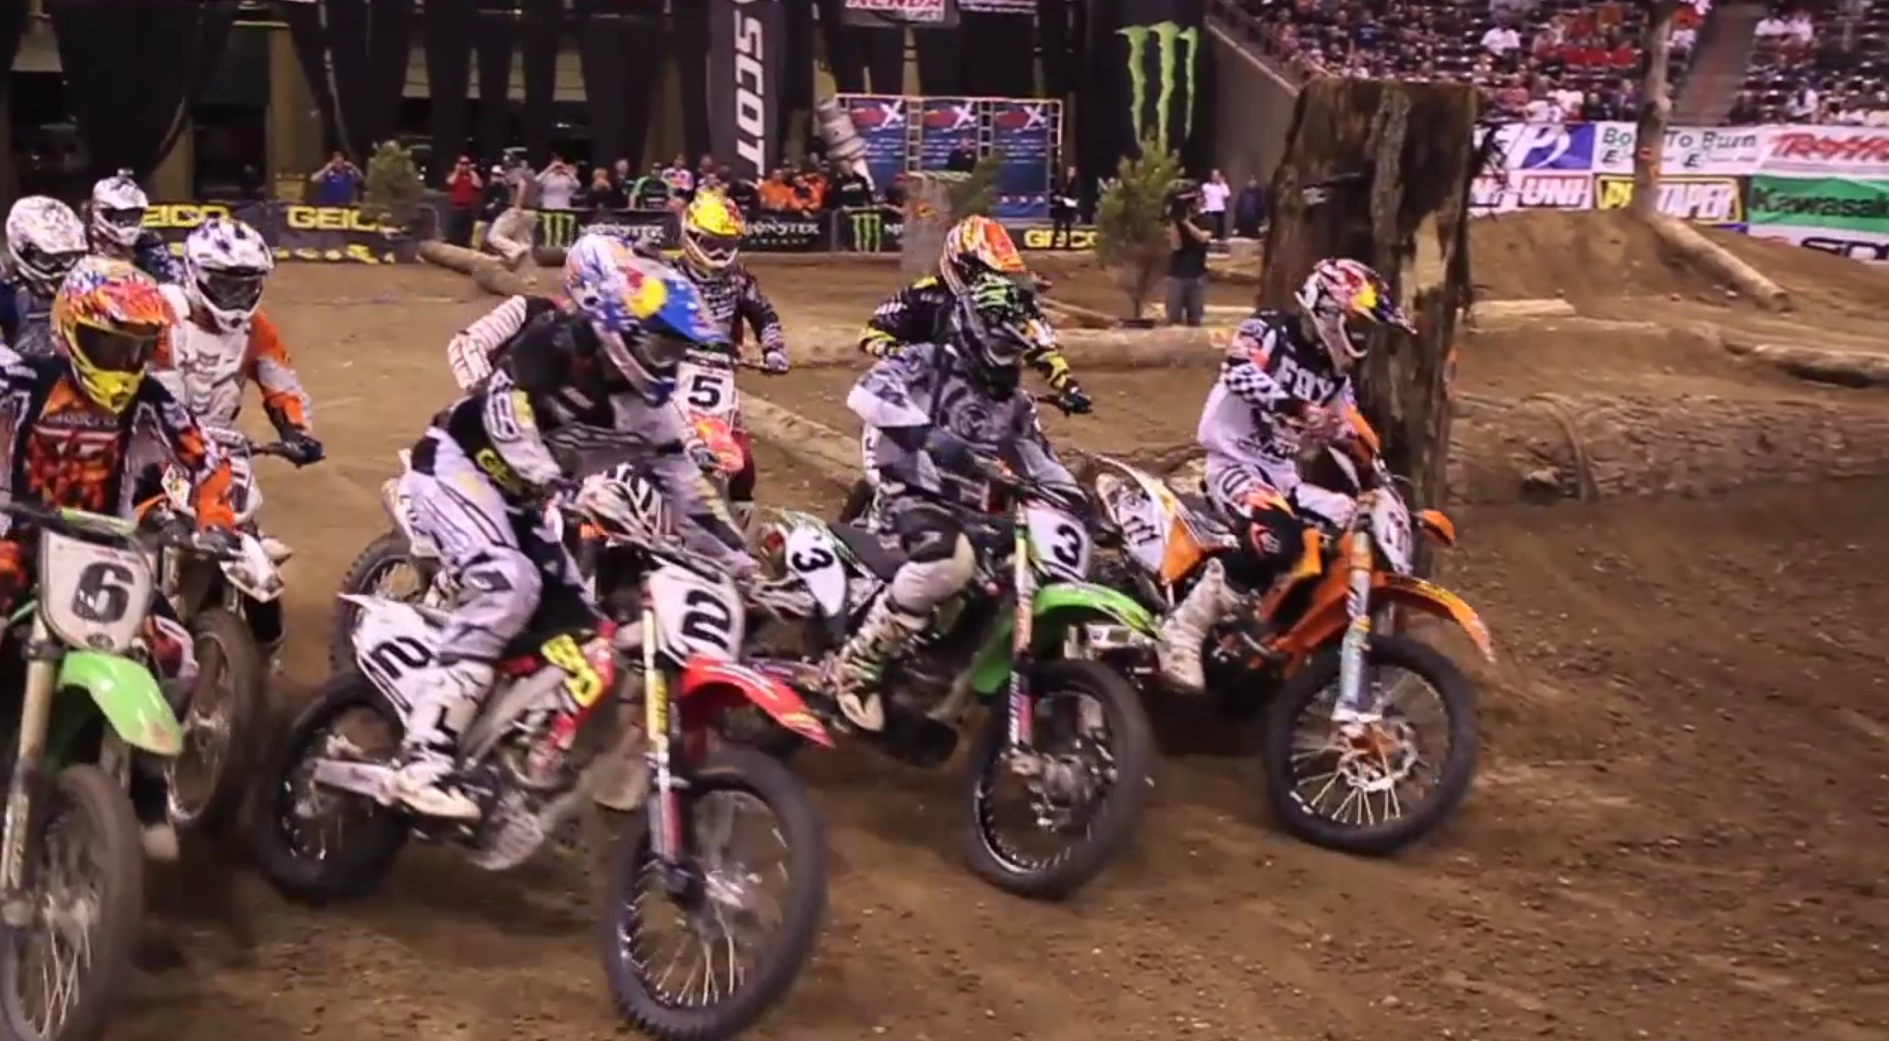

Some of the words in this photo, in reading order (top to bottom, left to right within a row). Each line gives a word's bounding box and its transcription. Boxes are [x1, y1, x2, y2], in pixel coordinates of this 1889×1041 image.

[734, 10, 765, 184] SCOT
[1602, 127, 1633, 146] Bo
[1664, 130, 1694, 148] To
[1702, 131, 1757, 150] Burn
[143, 205, 232, 227] EICO
[687, 374, 723, 409] 5
[792, 547, 834, 574] 3
[1053, 524, 1084, 569] 3
[71, 562, 136, 624] 6
[681, 588, 732, 650] 2
[370, 636, 432, 680] 2
